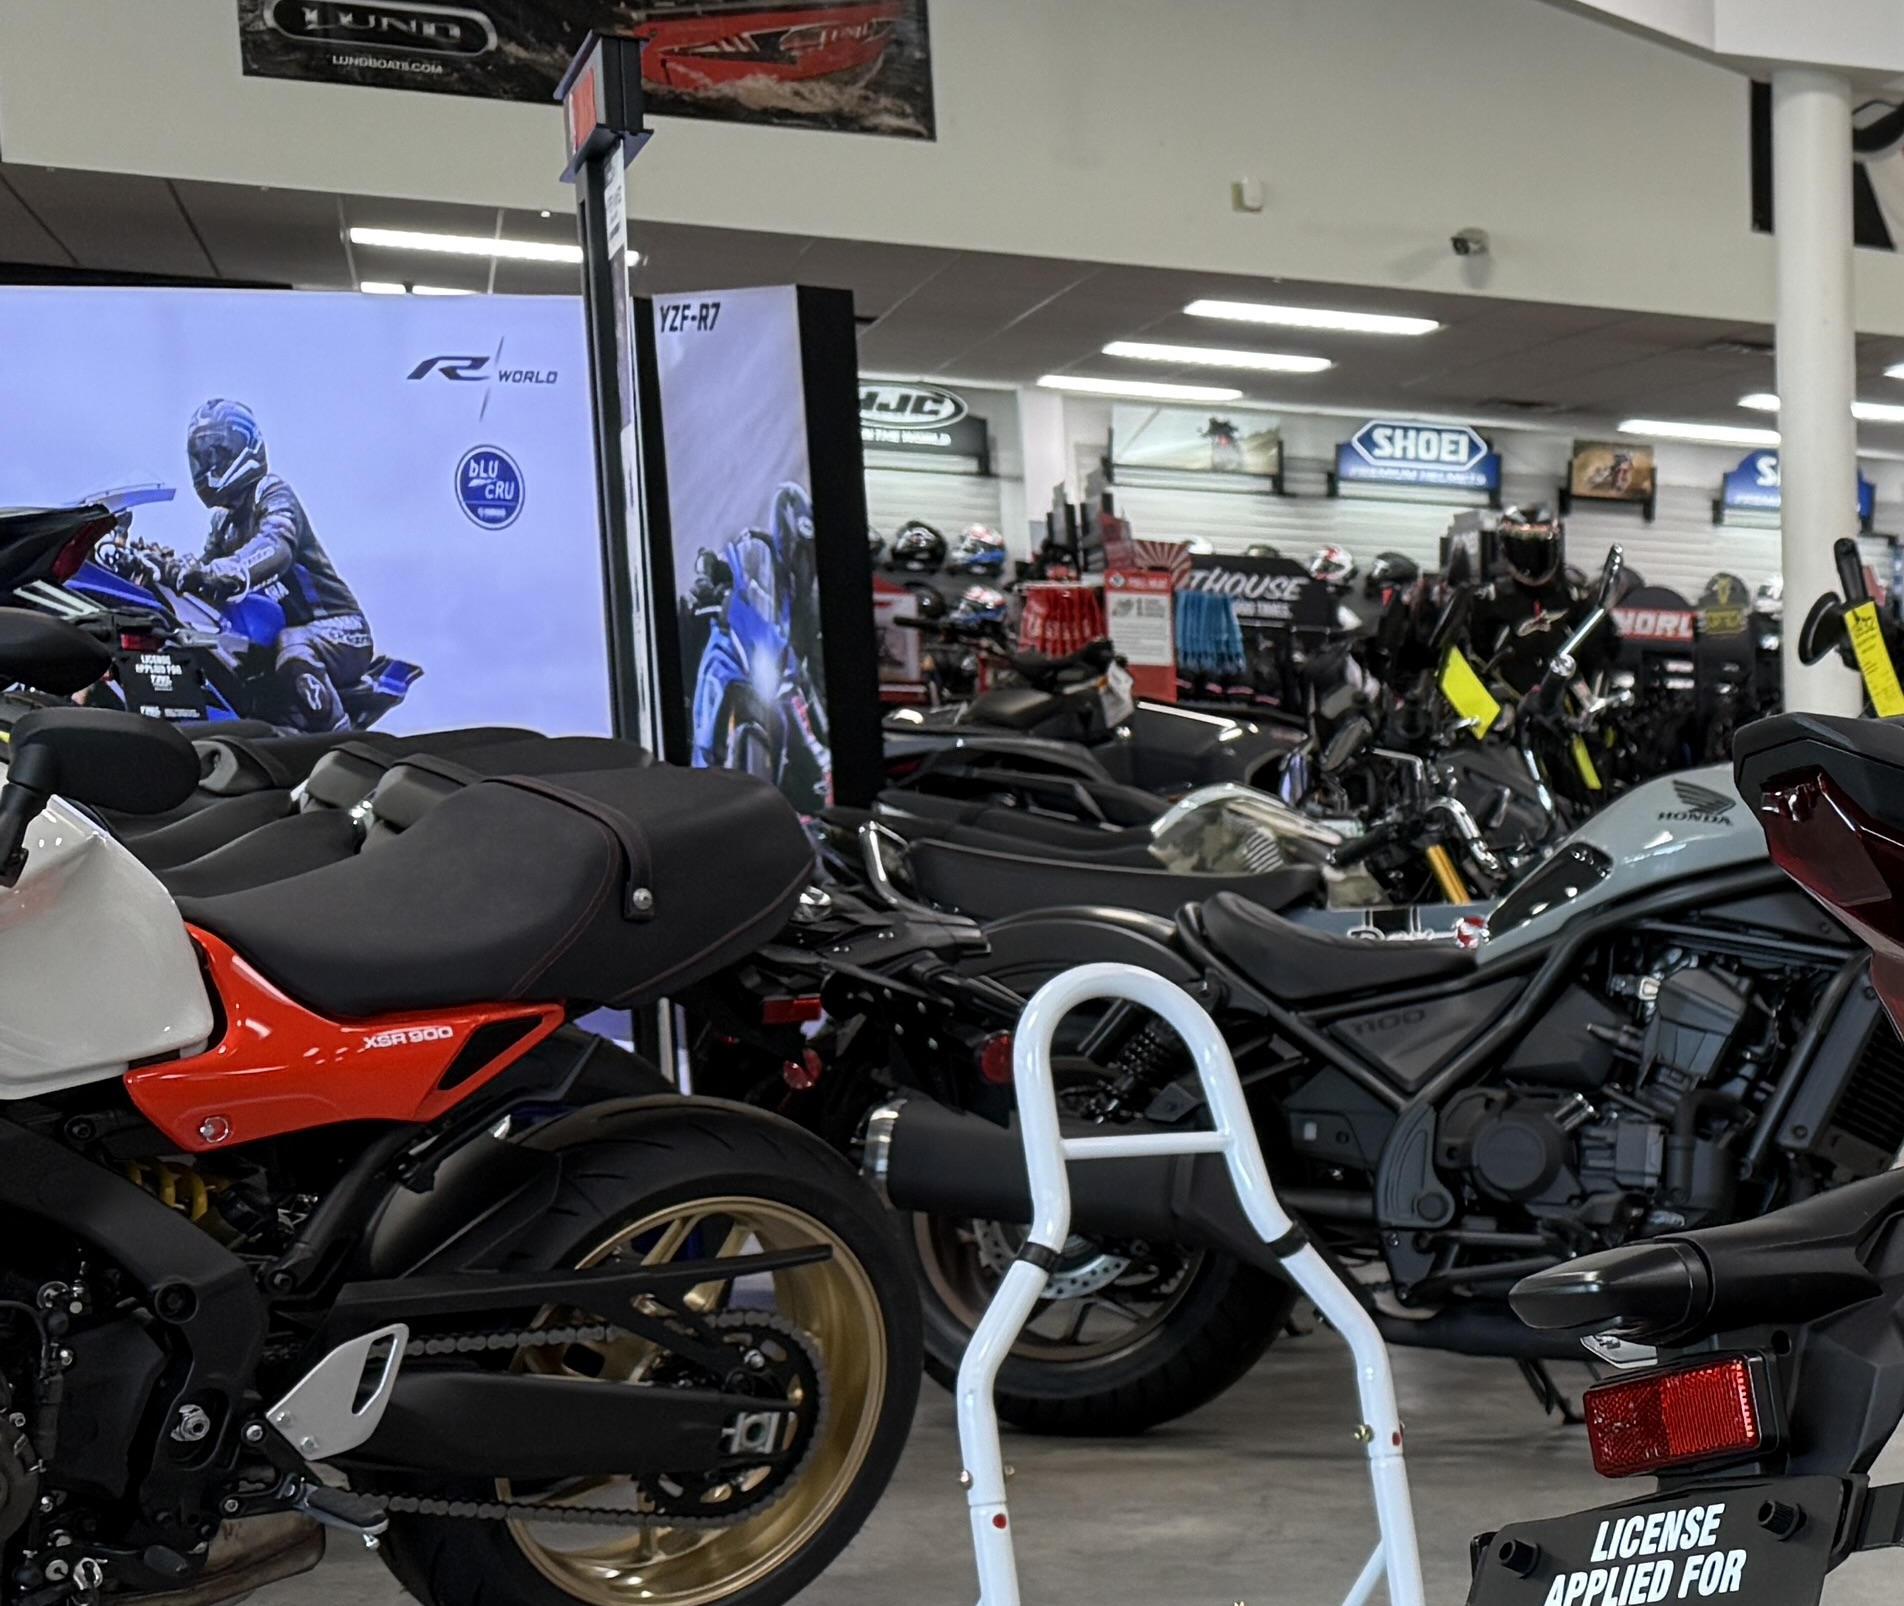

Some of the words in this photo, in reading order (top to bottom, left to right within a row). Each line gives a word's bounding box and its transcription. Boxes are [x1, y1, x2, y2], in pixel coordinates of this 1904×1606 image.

[301, 5, 461, 40] LUND
[332, 54, 444, 76] LUNDBOATS.COM
[659, 302, 721, 333] YZF-R7
[498, 369, 558, 385] WORLD
[1371, 426, 1470, 463] SHOEI
[1188, 567, 1310, 602] THOUSE
[1657, 811, 1733, 827] HONDA
[363, 1031, 408, 1049] XSR
[408, 1026, 454, 1044] 900
[1590, 1503, 1726, 1563] LICENSE
[1677, 1549, 1748, 1599] FOR
